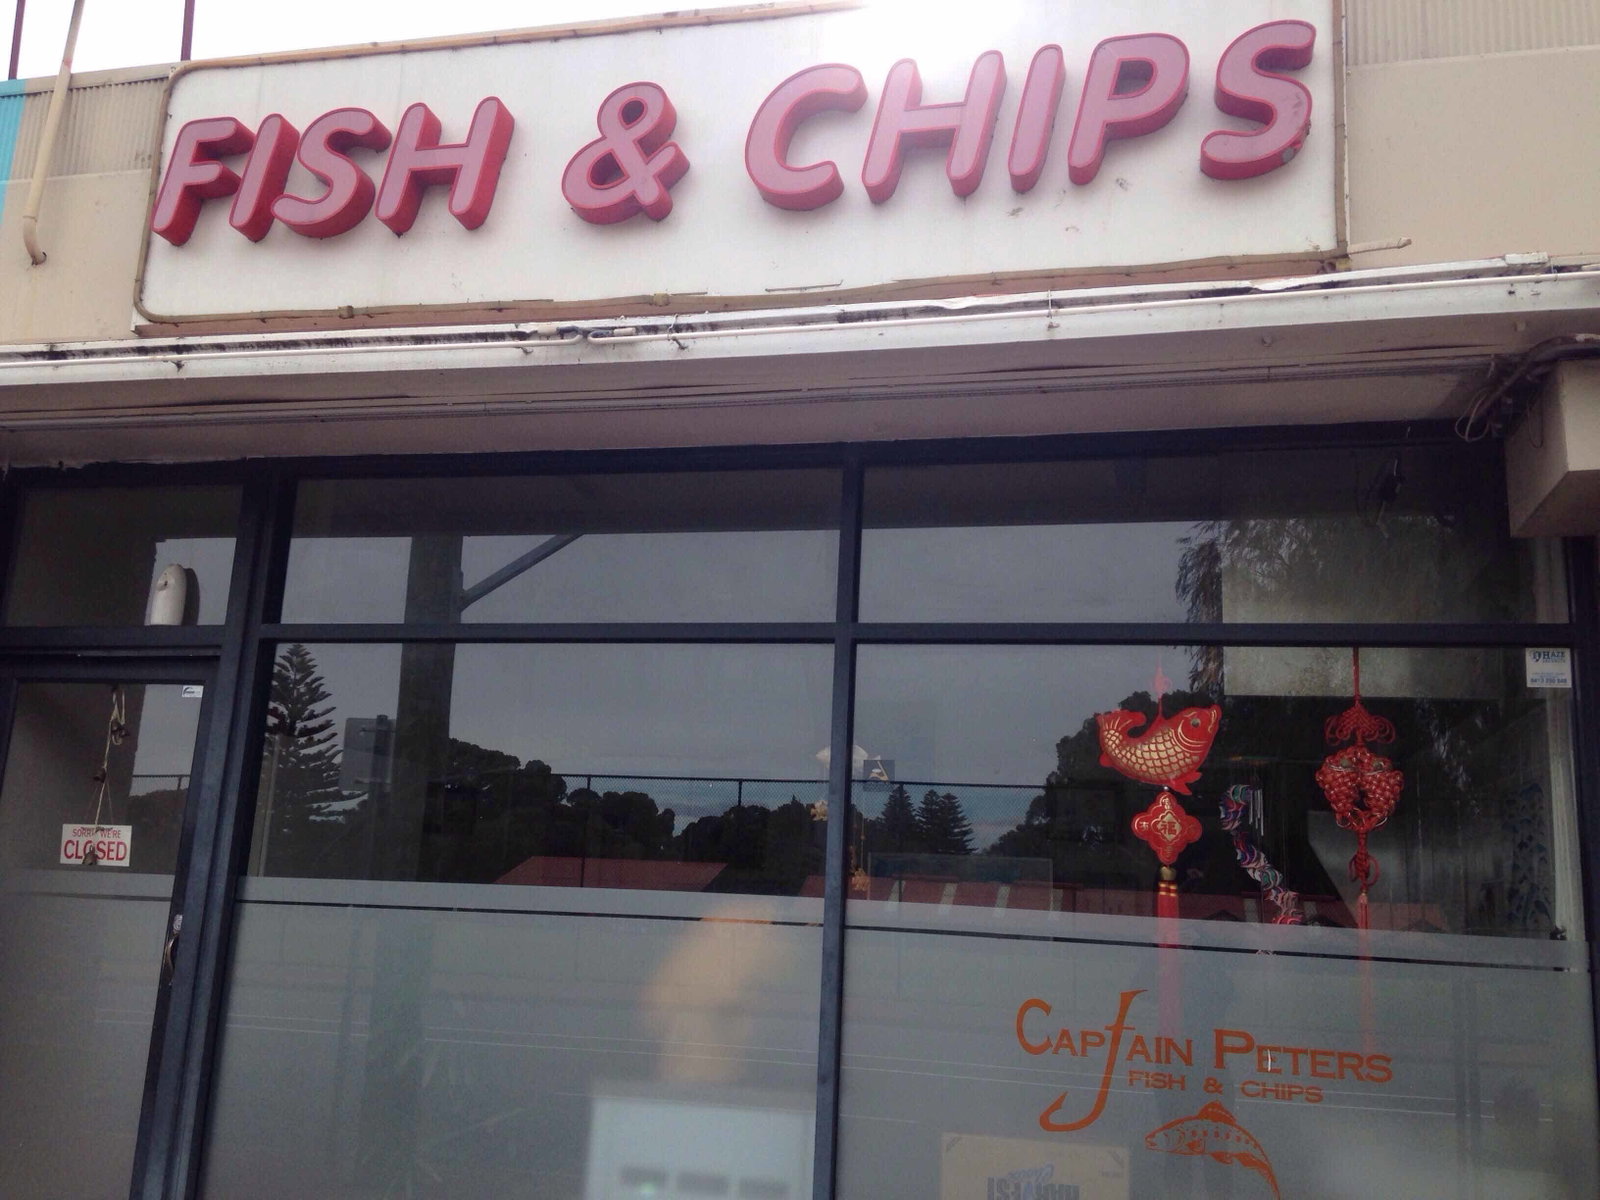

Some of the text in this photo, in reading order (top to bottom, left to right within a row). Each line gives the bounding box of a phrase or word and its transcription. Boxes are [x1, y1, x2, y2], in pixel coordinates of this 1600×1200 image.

[151, 19, 1317, 247] FISH & CHIPS
[63, 839, 127, 861] CLOSED
[1213, 1028, 1393, 1083] PETERS
[1128, 1070, 1324, 1103] FISH & CHIPS
